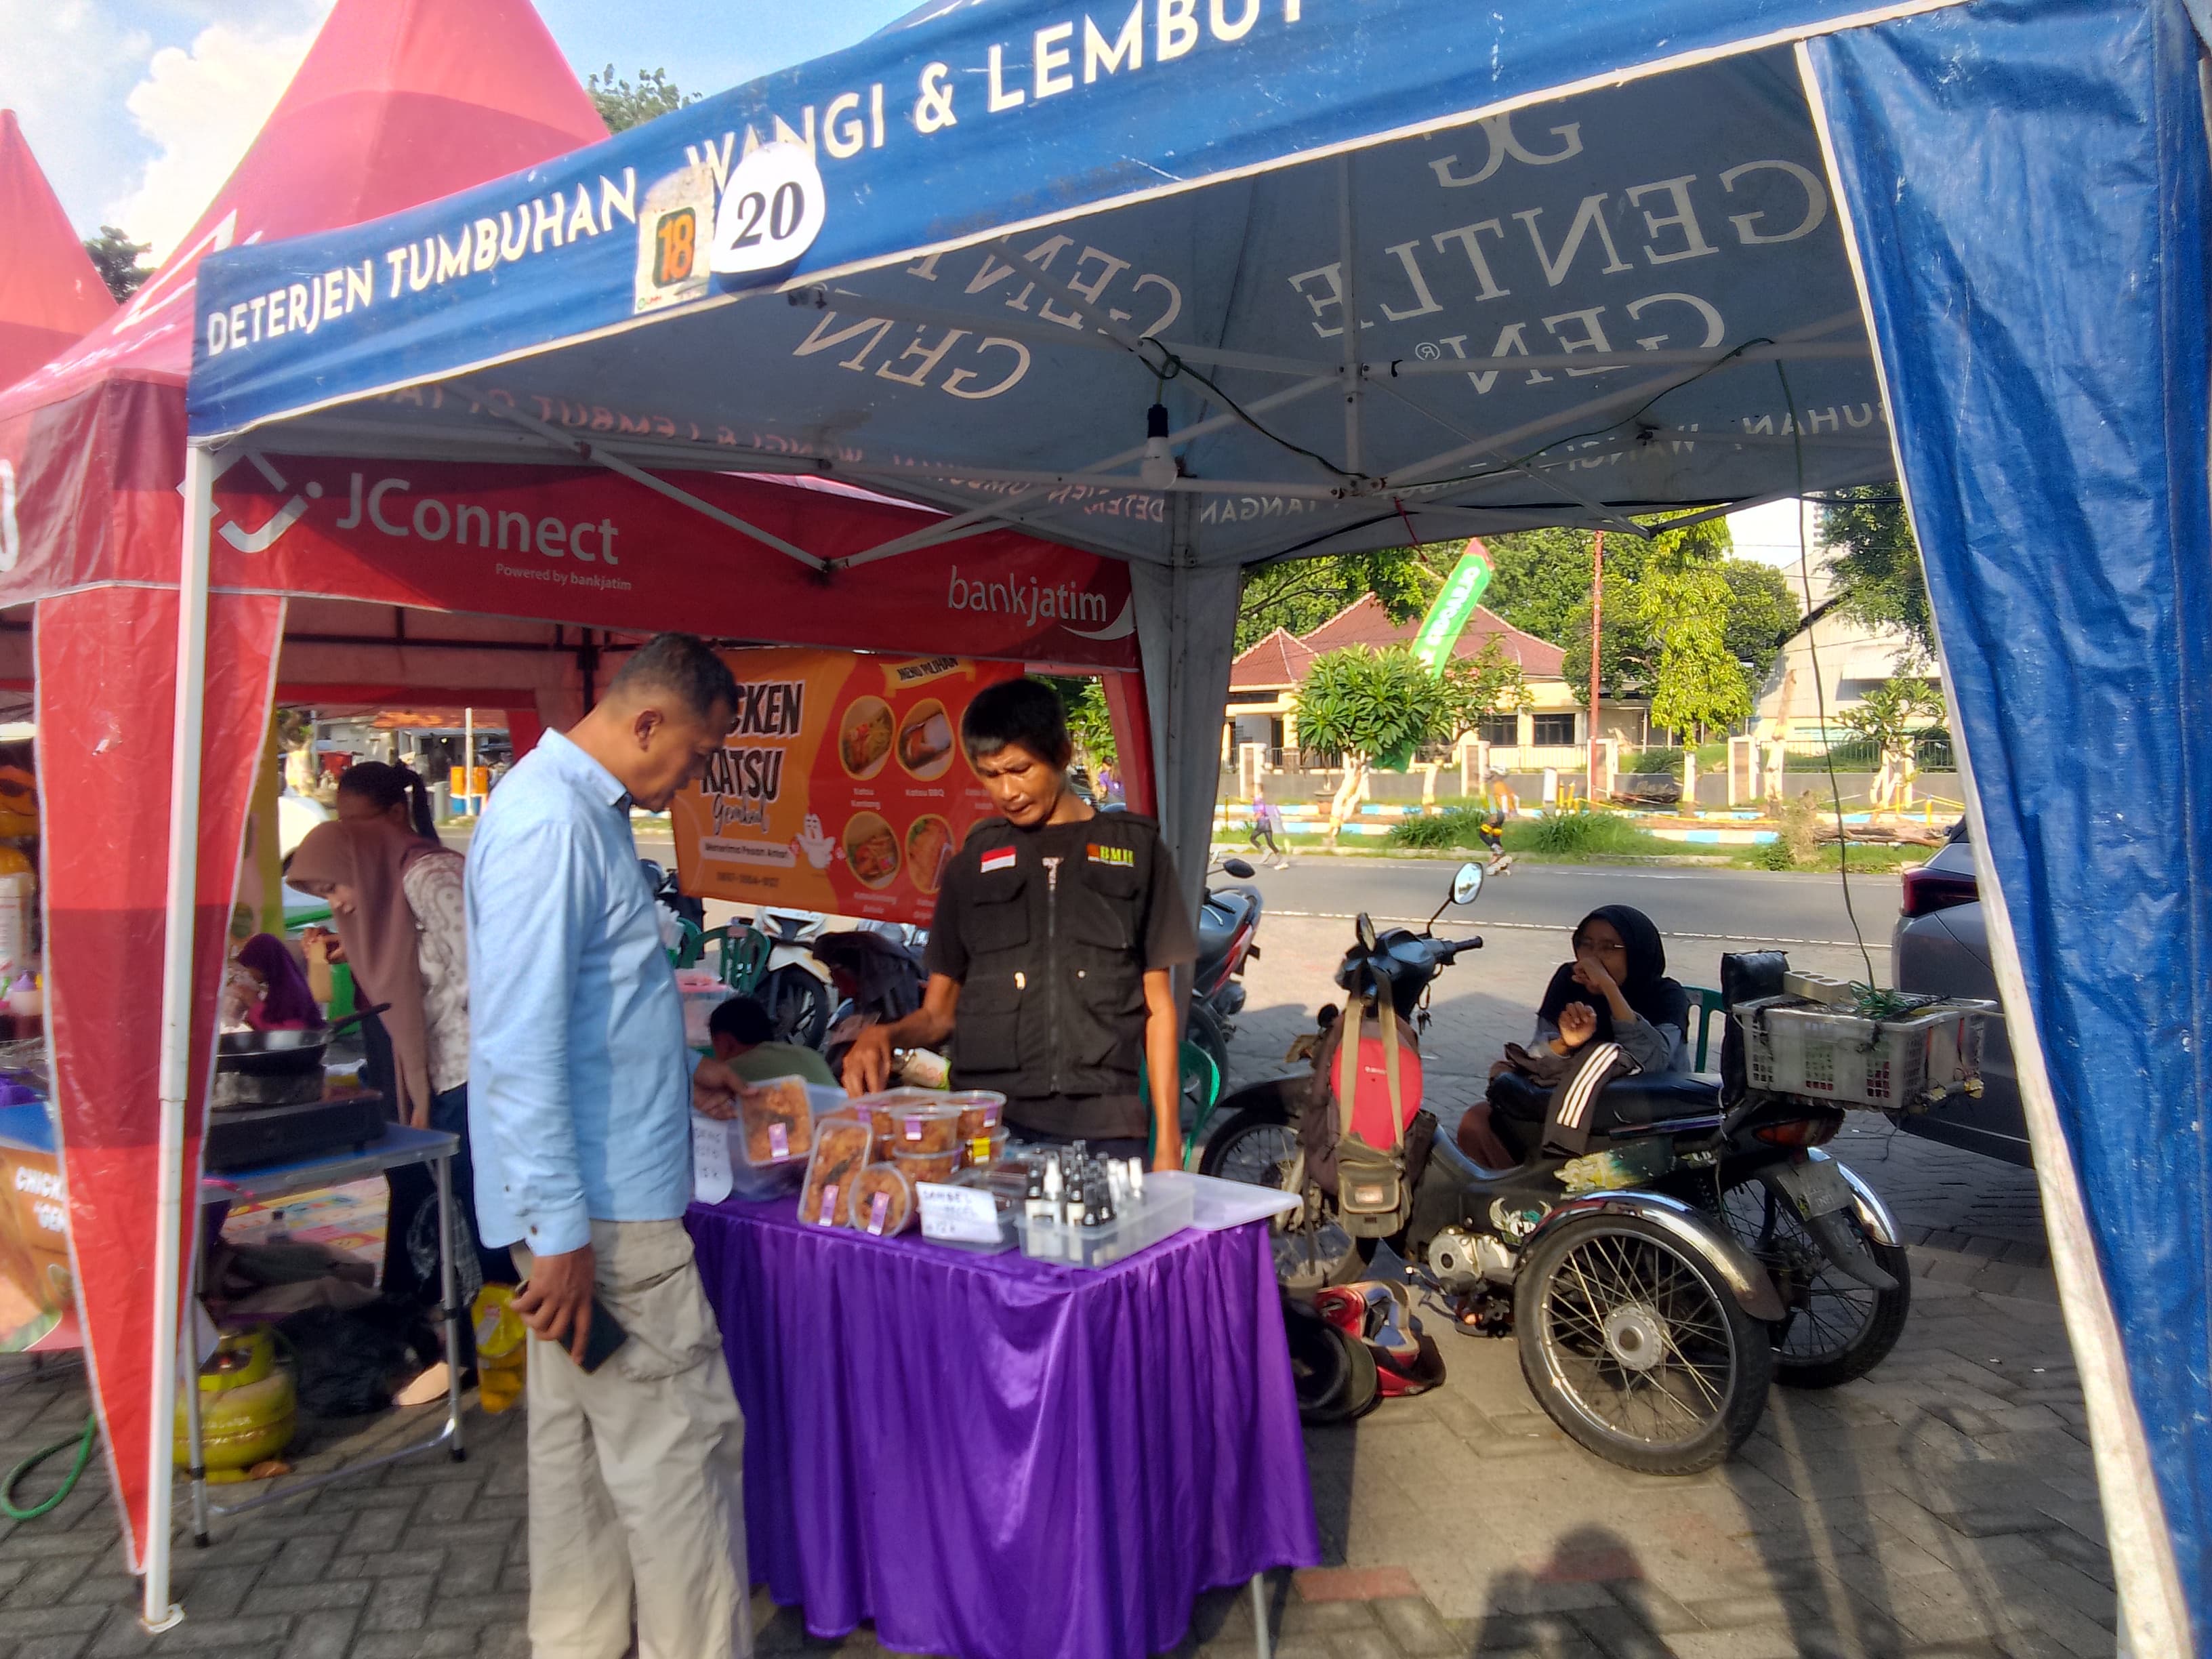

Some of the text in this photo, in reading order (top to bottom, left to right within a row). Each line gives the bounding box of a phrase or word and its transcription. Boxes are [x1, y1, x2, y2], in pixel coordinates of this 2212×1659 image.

[207, 256, 375, 357] DETERJEN
[385, 167, 636, 298] TUMBUHAN
[913, 62, 957, 134] &
[731, 181, 805, 250] 20
[657, 213, 695, 283] 18
[336, 472, 619, 565] JConnect
[495, 562, 632, 591] Powered by bankjatim
[948, 564, 1107, 628] bankjatim
[703, 747, 783, 801] KATSU
